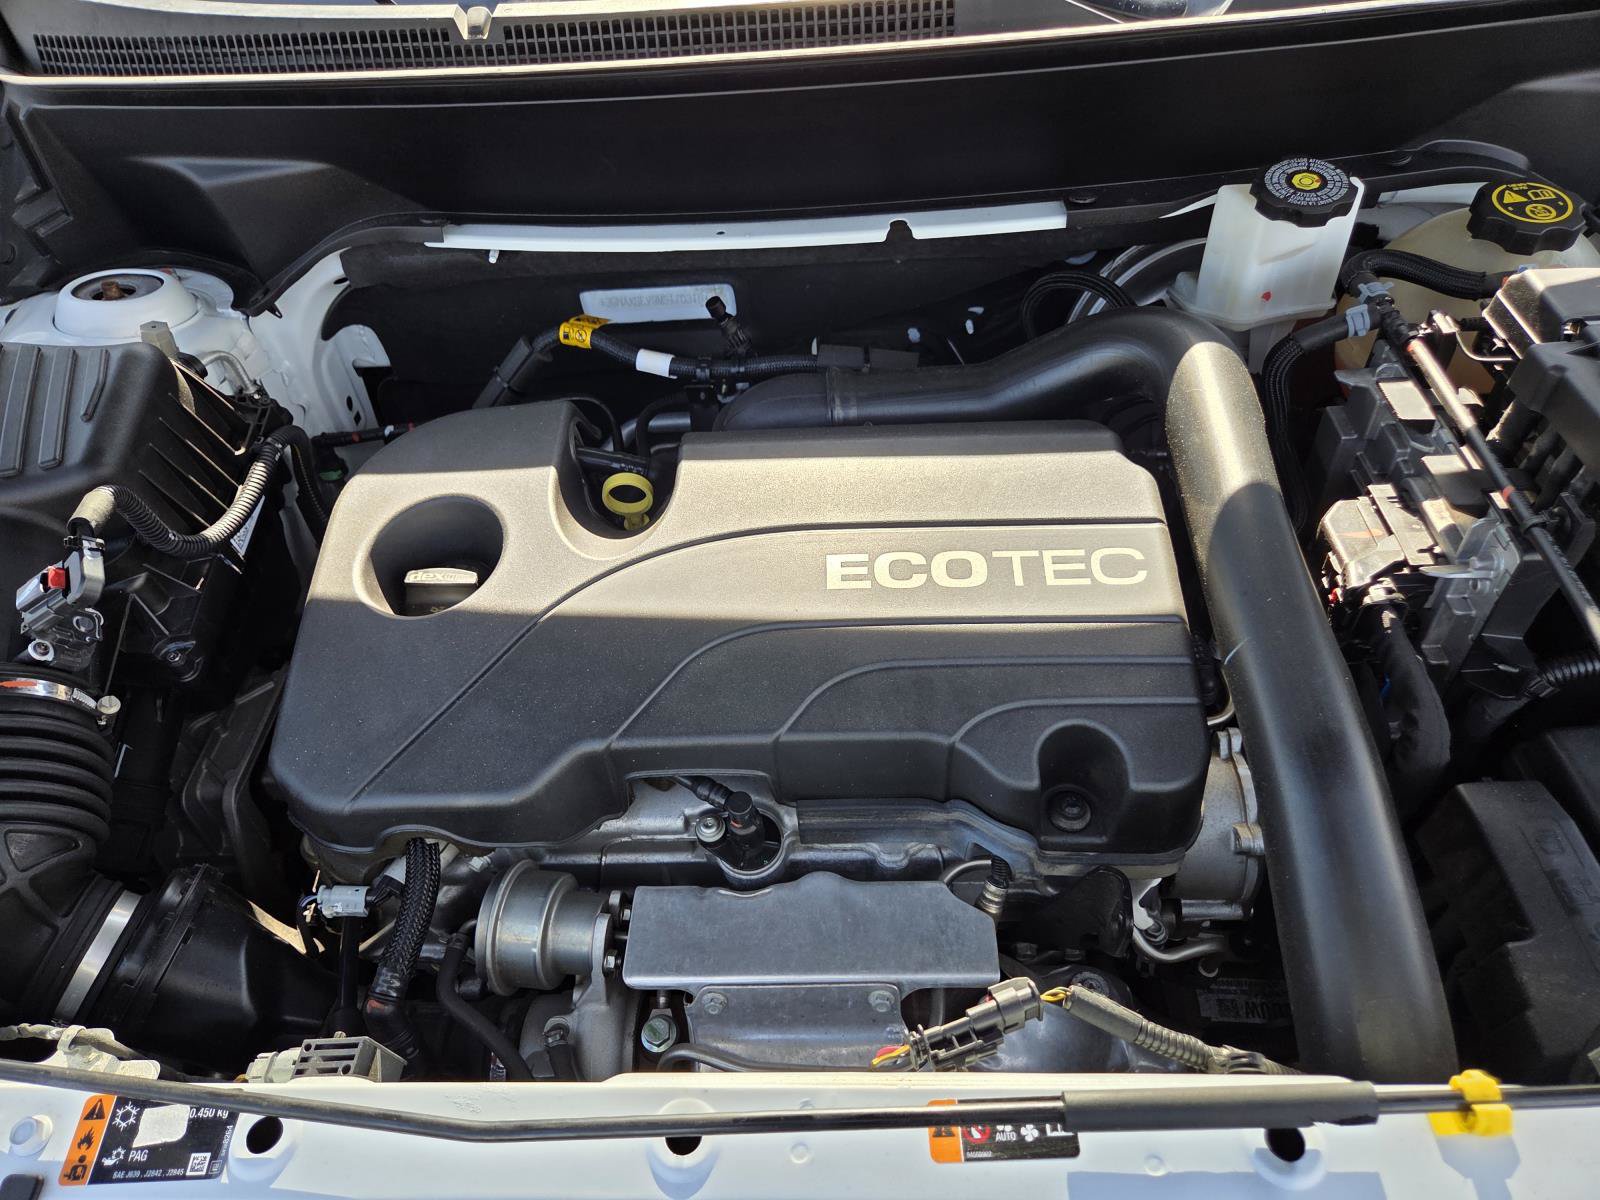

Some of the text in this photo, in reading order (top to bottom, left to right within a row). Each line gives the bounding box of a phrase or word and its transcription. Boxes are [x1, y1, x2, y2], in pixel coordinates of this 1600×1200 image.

[825, 547, 1148, 590] ECOTEC
[189, 1107, 216, 1118] 0.450
[995, 1131, 1017, 1142] AUTO
[128, 1149, 149, 1162] PAG
